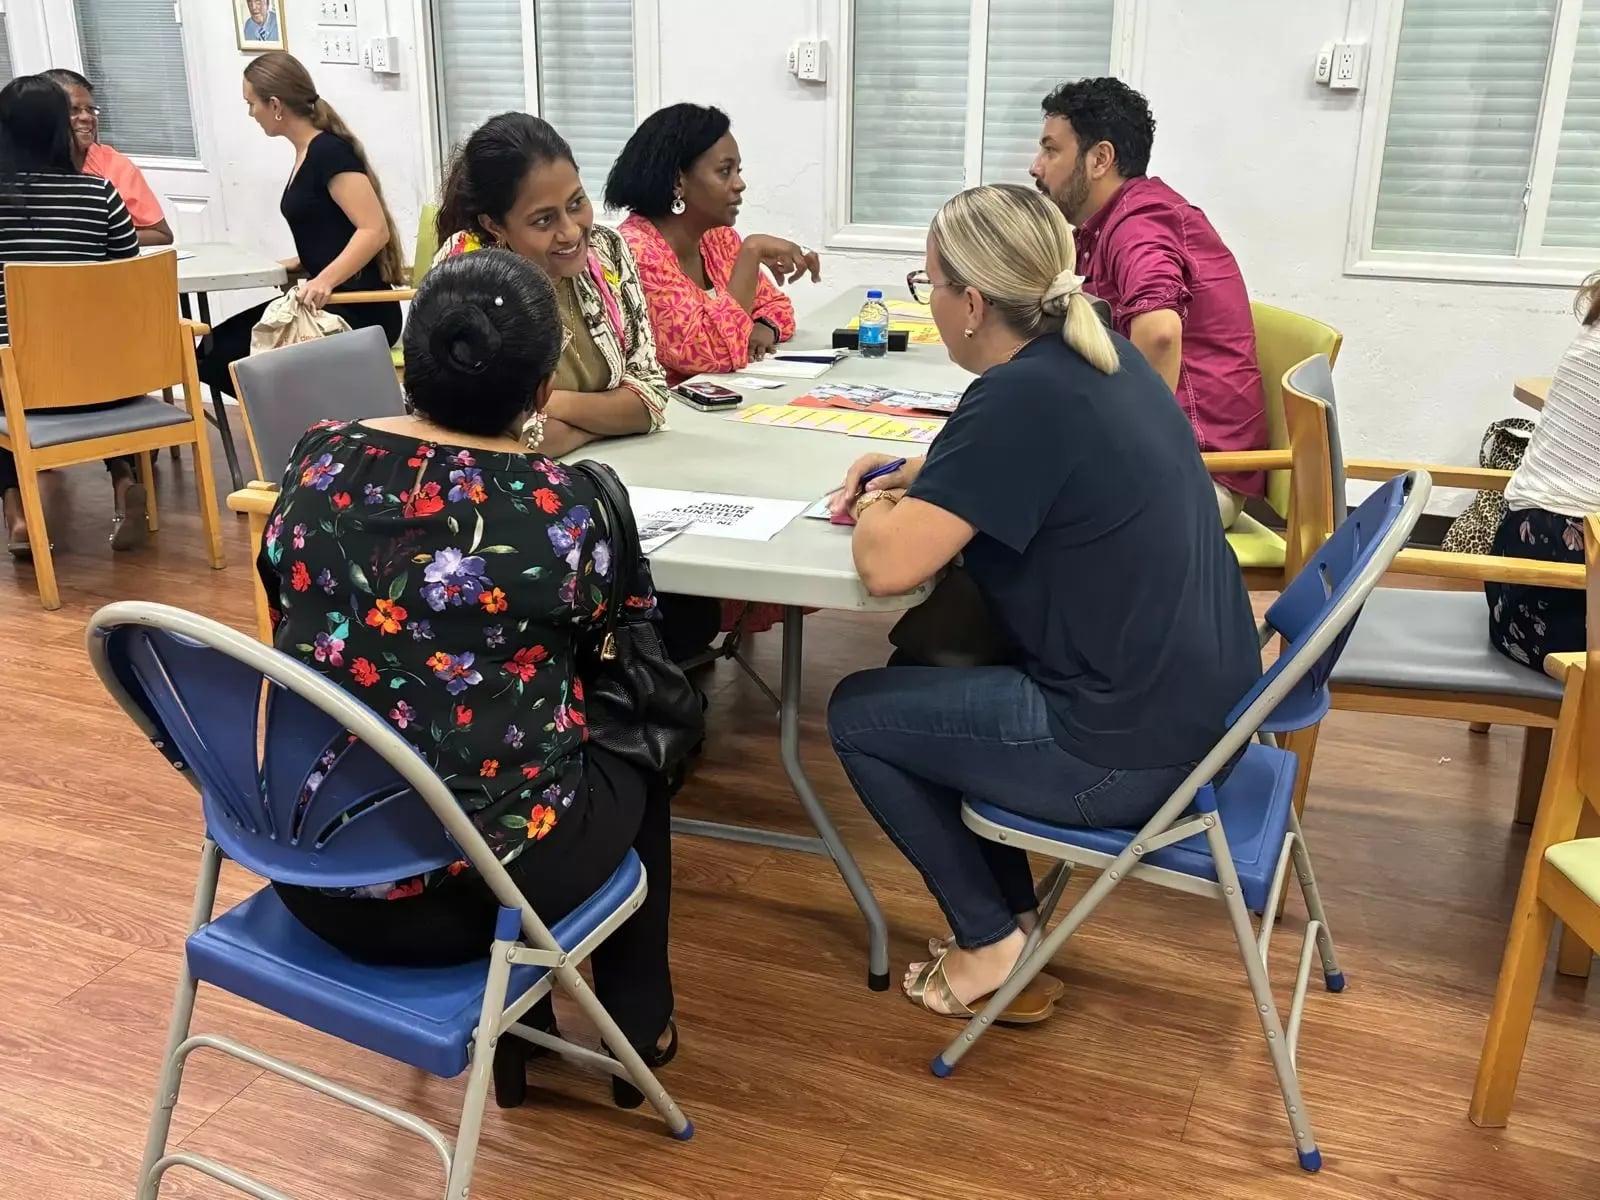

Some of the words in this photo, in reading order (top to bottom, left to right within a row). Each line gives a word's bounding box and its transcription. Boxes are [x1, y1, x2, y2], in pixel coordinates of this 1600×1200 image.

[687, 504, 749, 514] PODIUM
[702, 502, 754, 510] FONDS
[672, 508, 744, 518] KUNSTEN
